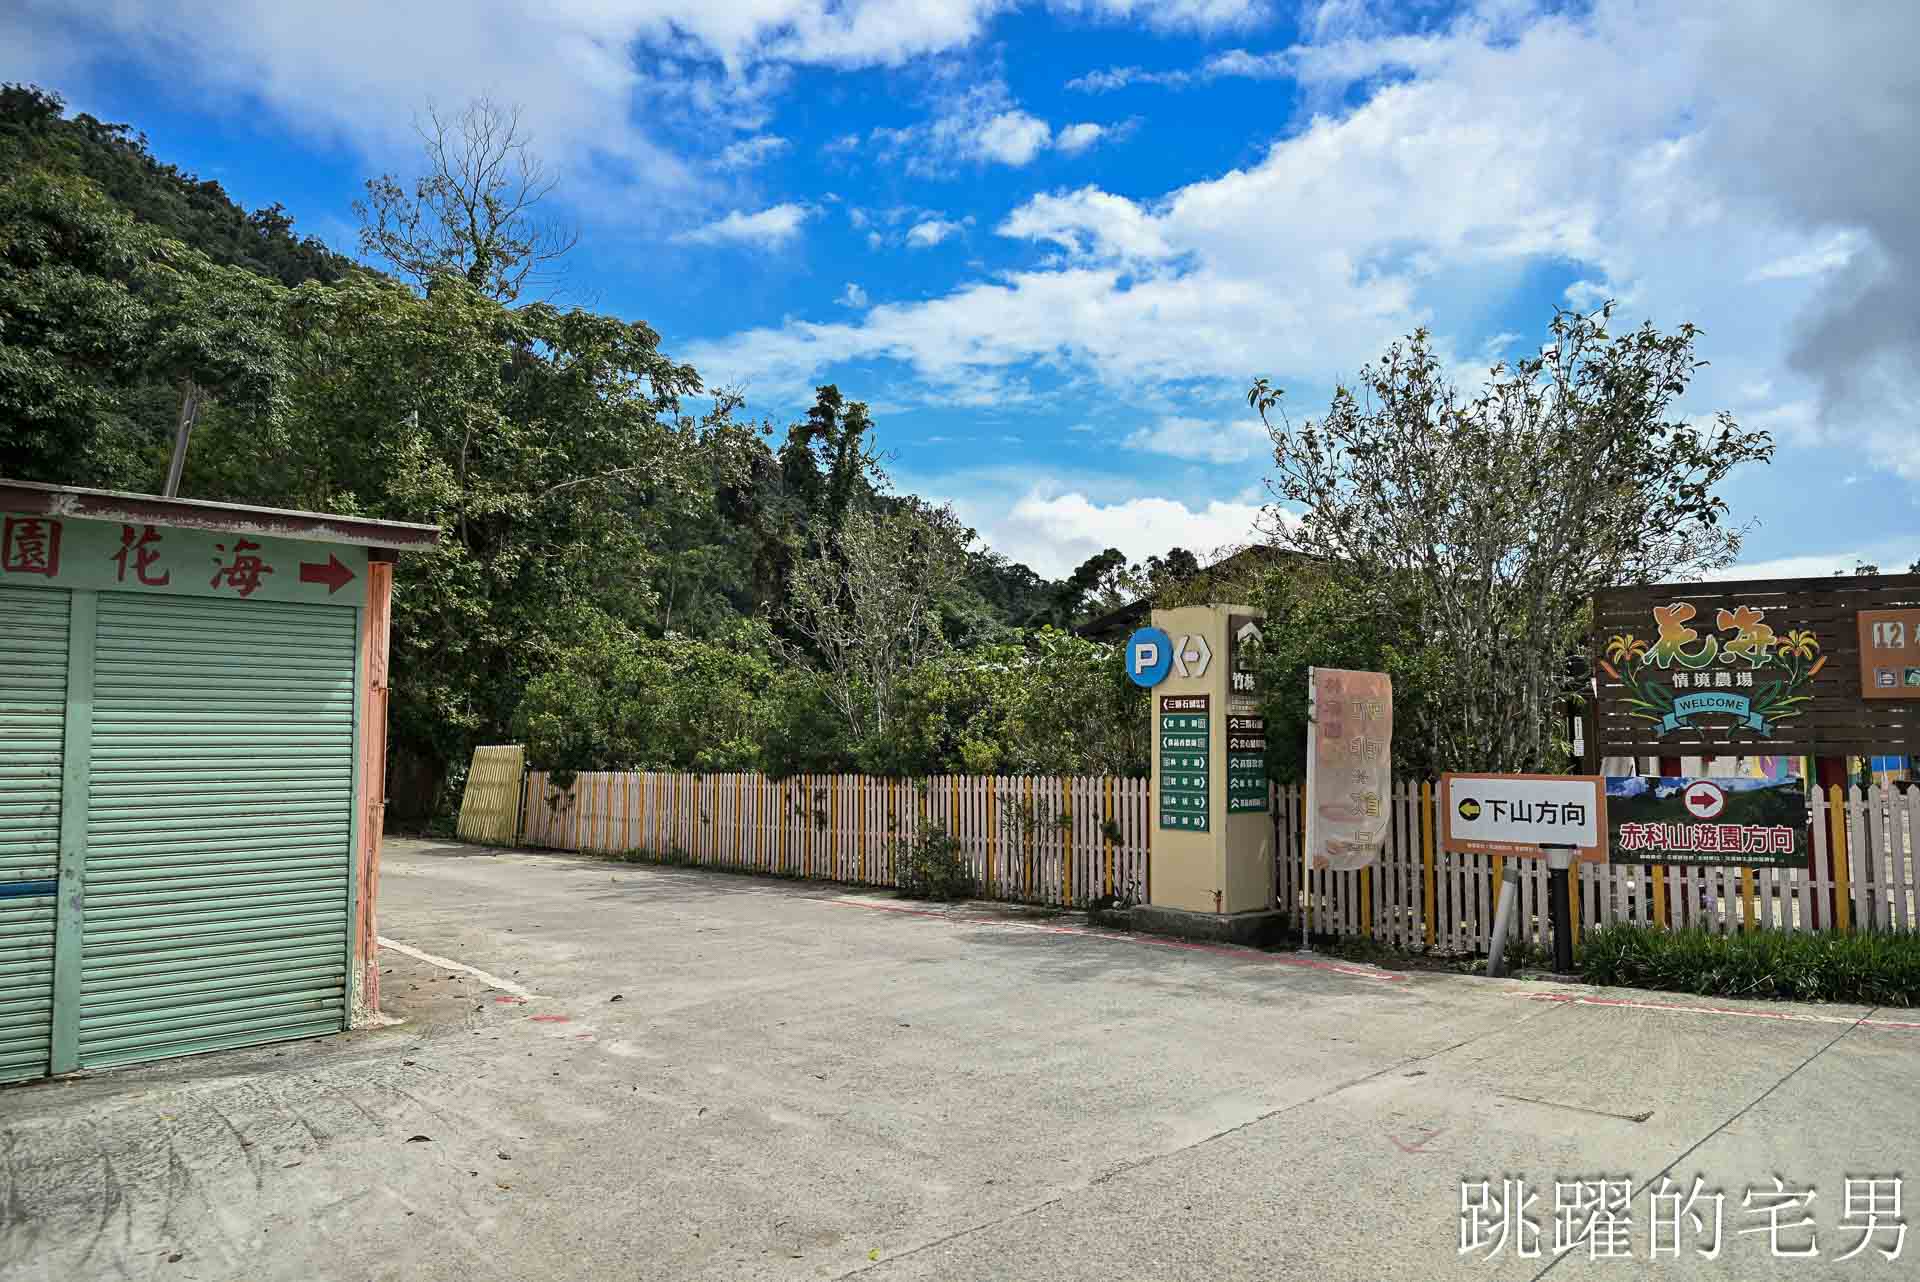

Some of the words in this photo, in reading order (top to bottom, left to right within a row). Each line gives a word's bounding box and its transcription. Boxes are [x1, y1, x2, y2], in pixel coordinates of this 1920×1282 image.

[1135, 643, 1158, 675] P
[1672, 672, 1753, 689] 情境農場
[1679, 699, 1744, 712] WELCOME
[1485, 799, 1586, 826] 下山方向
[1619, 822, 1795, 853] 赤科山遊園方向
